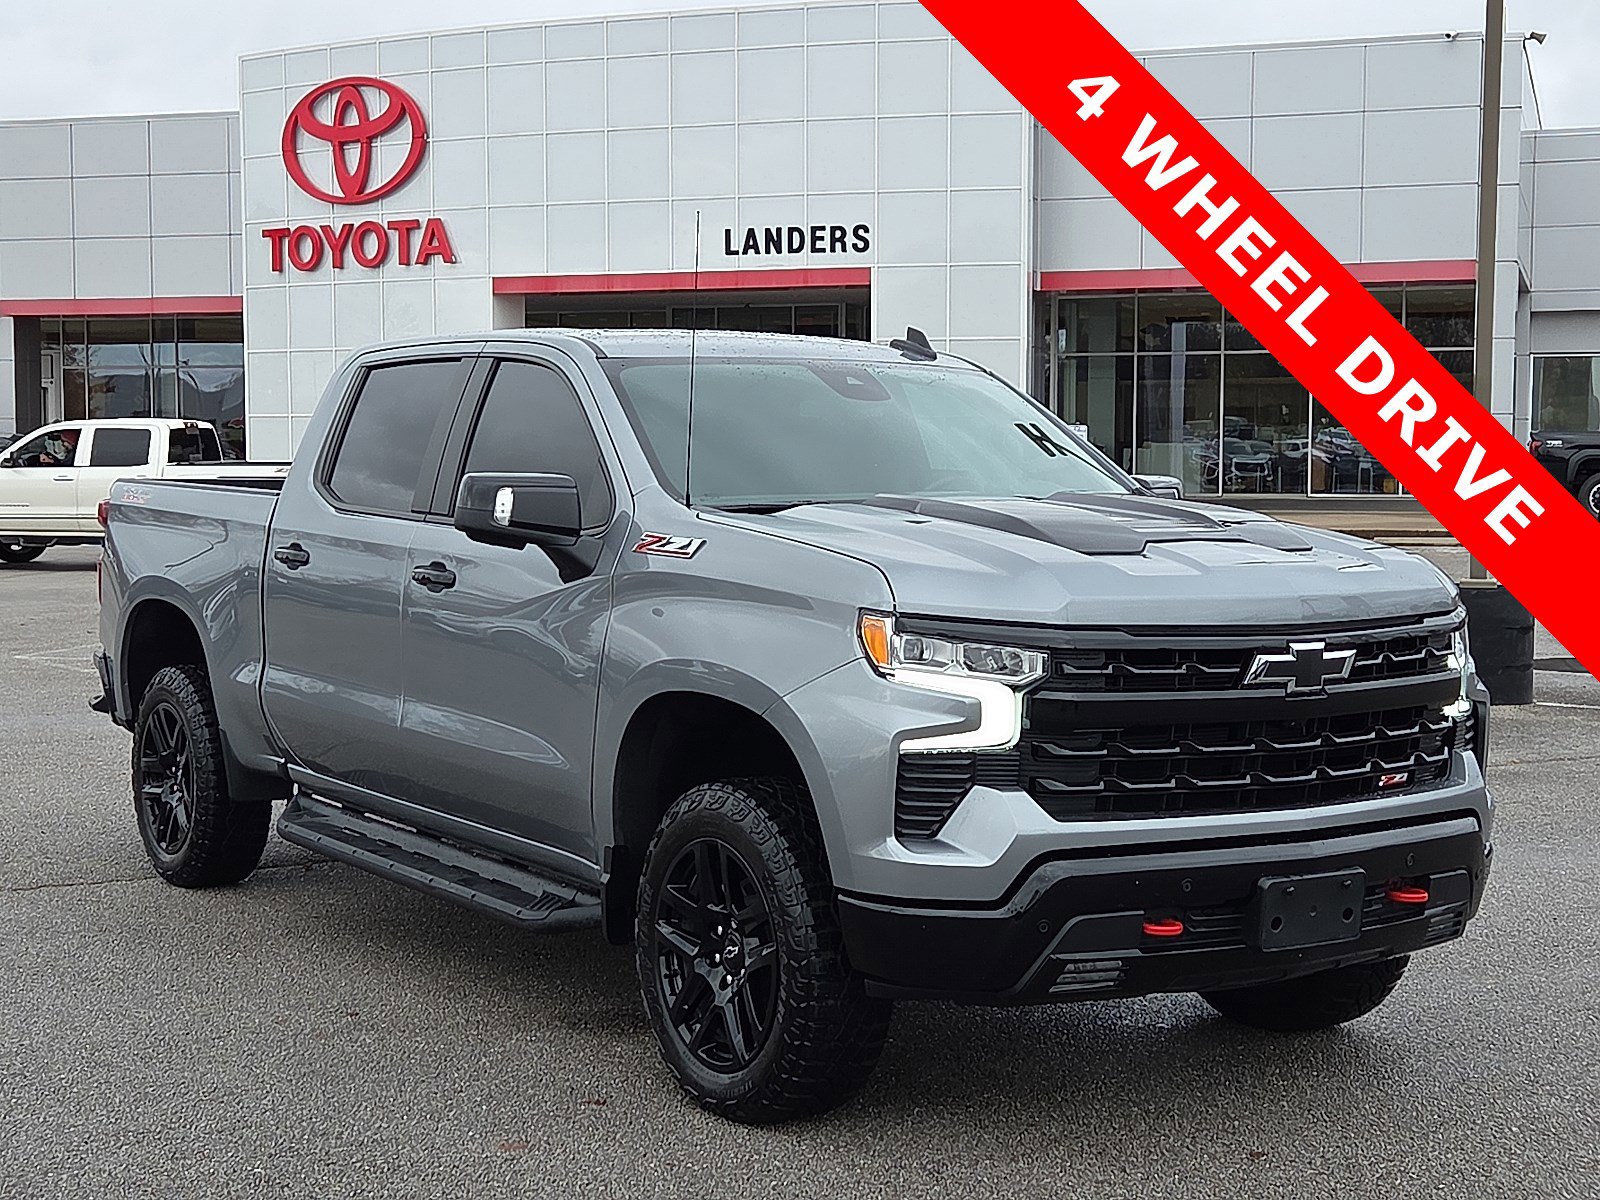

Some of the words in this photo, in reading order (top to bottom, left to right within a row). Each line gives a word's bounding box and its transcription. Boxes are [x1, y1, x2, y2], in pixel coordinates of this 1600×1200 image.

[263, 219, 456, 271] TOYOTA
[724, 225, 870, 256] LANDERS
[632, 531, 706, 558] Z71
